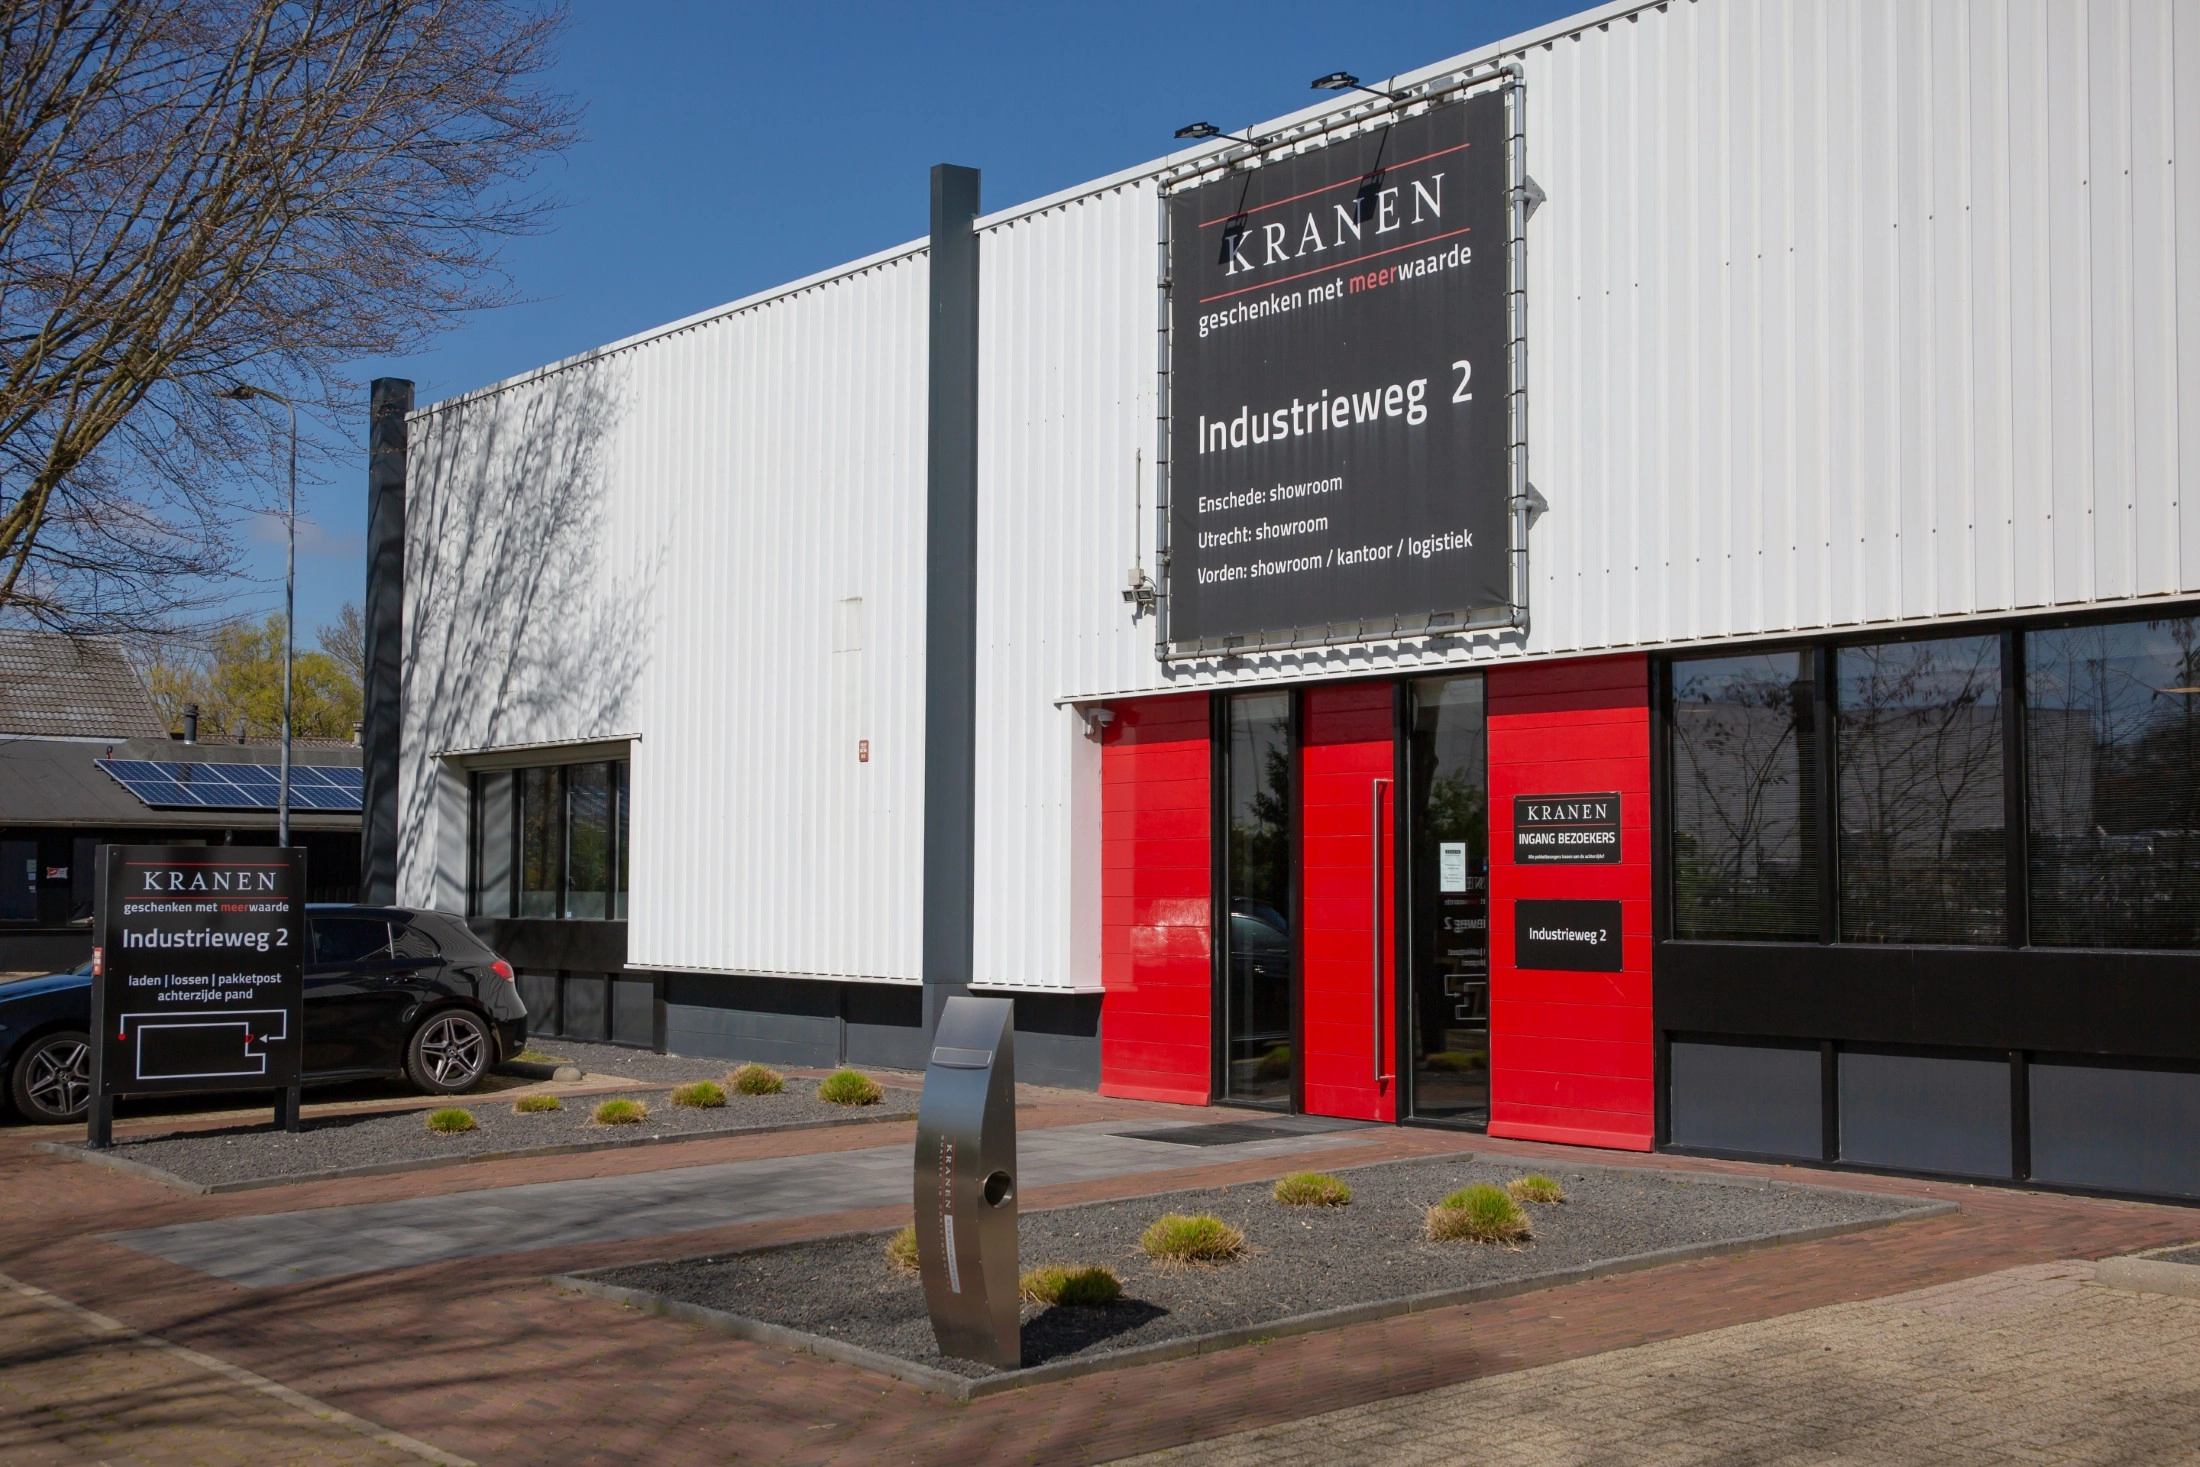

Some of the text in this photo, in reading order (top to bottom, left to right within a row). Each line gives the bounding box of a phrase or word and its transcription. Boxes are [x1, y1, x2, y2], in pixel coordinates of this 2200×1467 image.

[1226, 173, 1445, 276] KRANEN
[1199, 244, 1472, 337] geschenken met meerwaarde
[1199, 360, 1473, 455] Industrieweg 2
[1198, 476, 1343, 513] Enschede: showroom
[1198, 515, 1328, 549] Utrecht: showroom
[1198, 564, 1248, 584] Vorden:
[1250, 552, 1322, 578] showroom
[1336, 544, 1393, 566] kantoor
[1408, 529, 1473, 558] logistiek
[1528, 804, 1607, 821] KRANEN
[1519, 832, 1615, 845] INGANG BEZOEKERS
[143, 871, 277, 891] KRANEN
[124, 901, 289, 915] geschenken met meerwaarde
[123, 928, 289, 951] Industrieweg 2
[1529, 927, 1607, 945] Industrieweg 2
[129, 975, 162, 986] laden
[171, 974, 209, 986] lossen
[218, 973, 282, 988] pakketpost
[158, 989, 253, 1002] achterzijde pand
[945, 1144, 953, 1208] KRANEN
